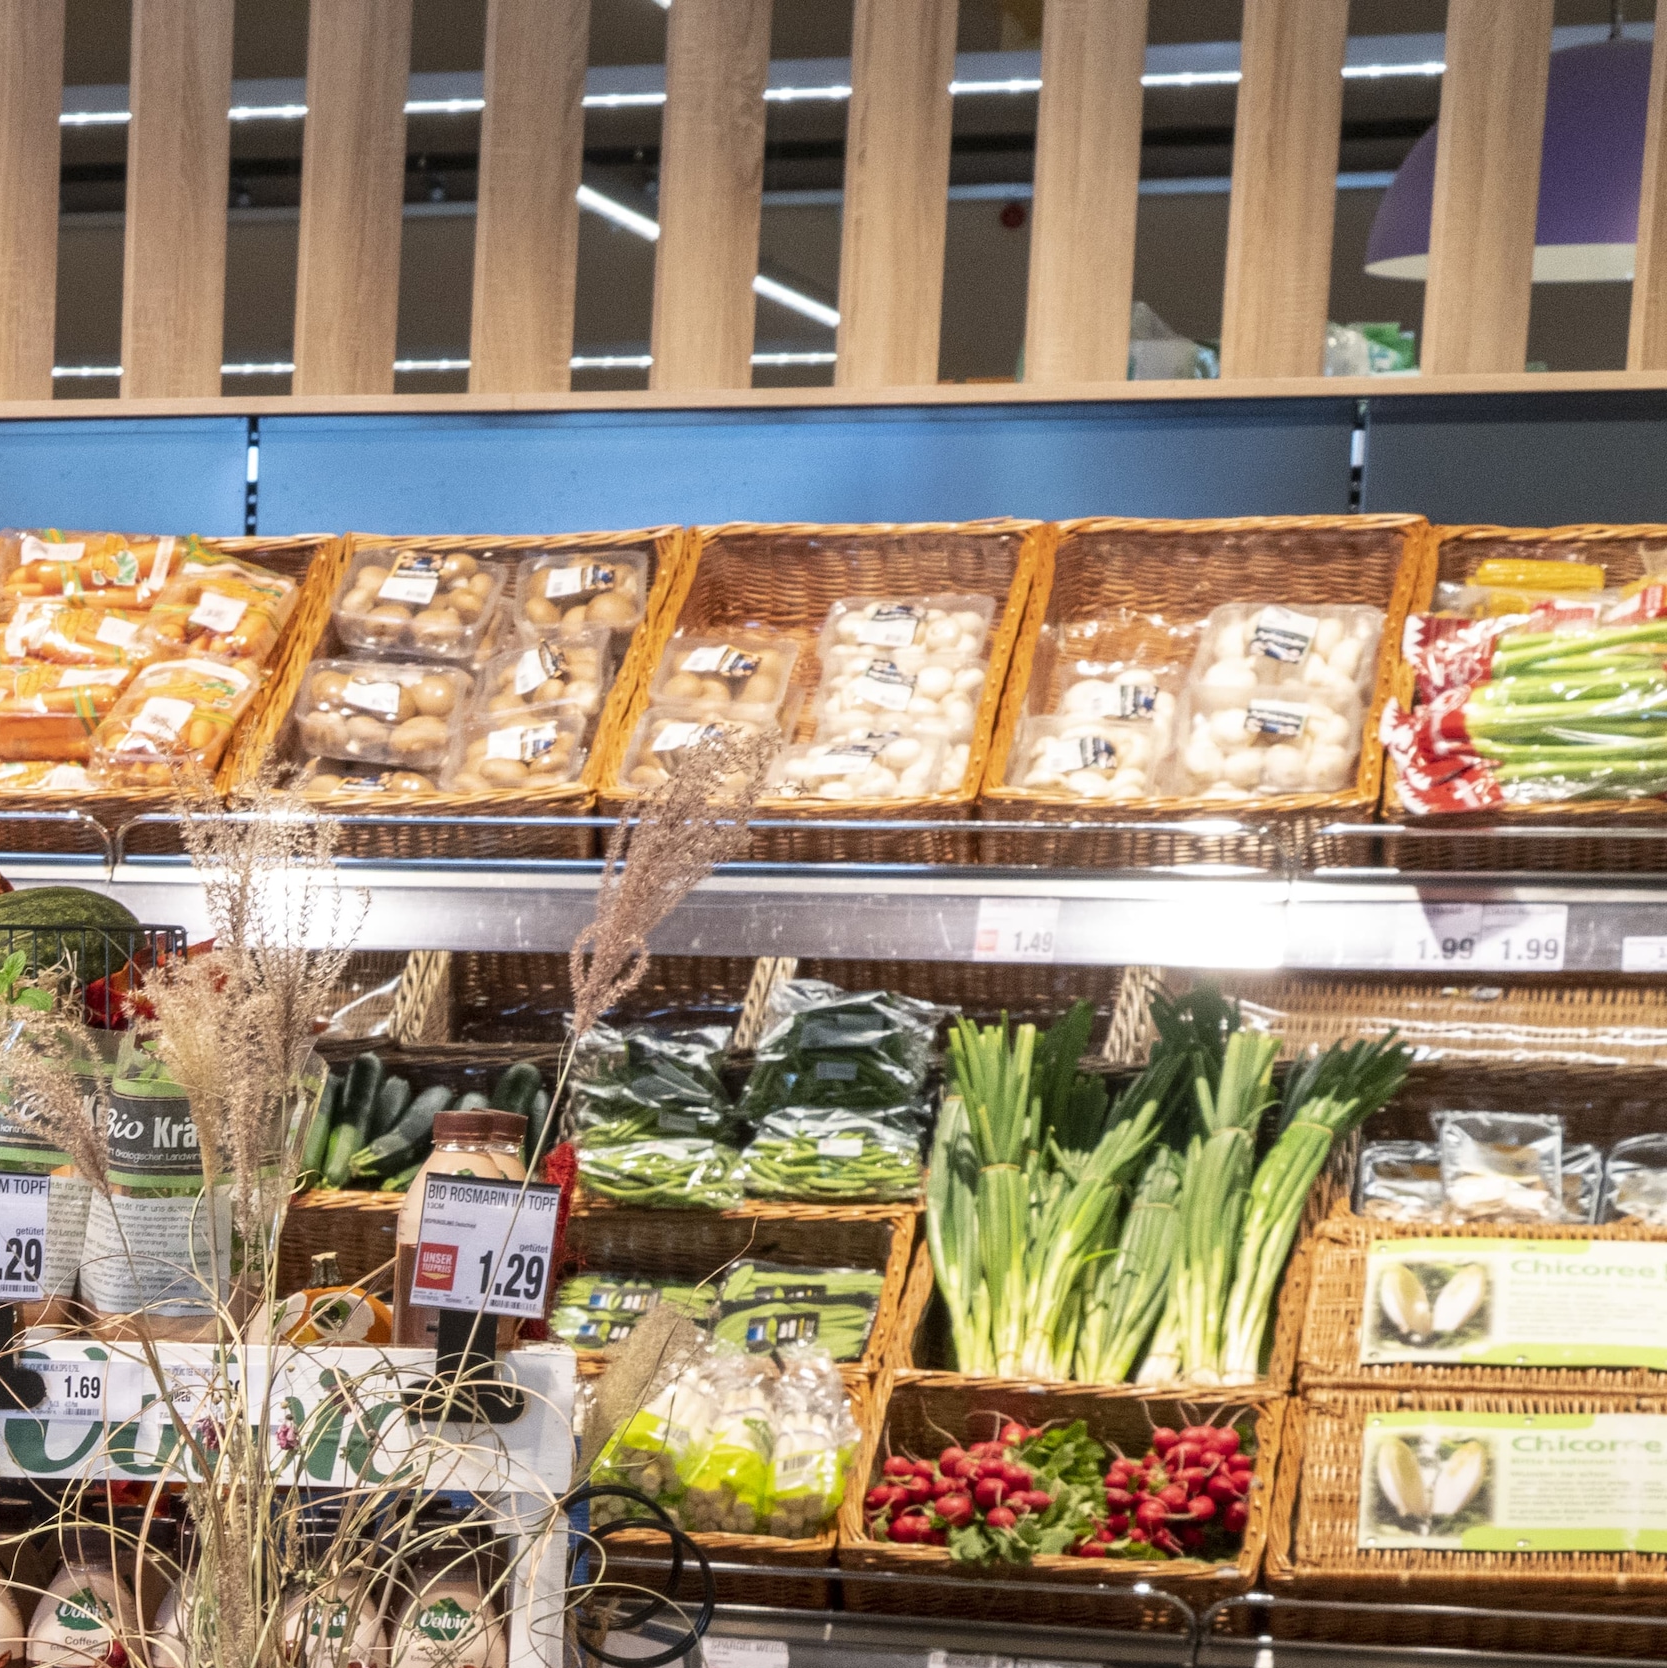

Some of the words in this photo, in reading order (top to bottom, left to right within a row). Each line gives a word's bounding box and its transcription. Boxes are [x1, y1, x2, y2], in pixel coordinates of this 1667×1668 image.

[1012, 931, 1054, 954] 1.49
[1416, 937, 1474, 961] 1.99
[1500, 938, 1559, 962] 1.99
[13, 1179, 47, 1195] TOPF
[427, 1184, 448, 1200] BIO
[449, 1186, 510, 1207] ROSMARIN
[528, 1194, 557, 1213] TOPF
[15, 1227, 45, 1237] getütet
[422, 1251, 453, 1265] UNSER
[422, 1263, 452, 1274] TIEFPREIS
[478, 1249, 545, 1301] 1.29
[1510, 1259, 1657, 1279] Chicoree
[63, 1375, 101, 1400] 1.69
[1511, 1435, 1663, 1454] Chicore
[64, 1635, 99, 1647] Coffee
